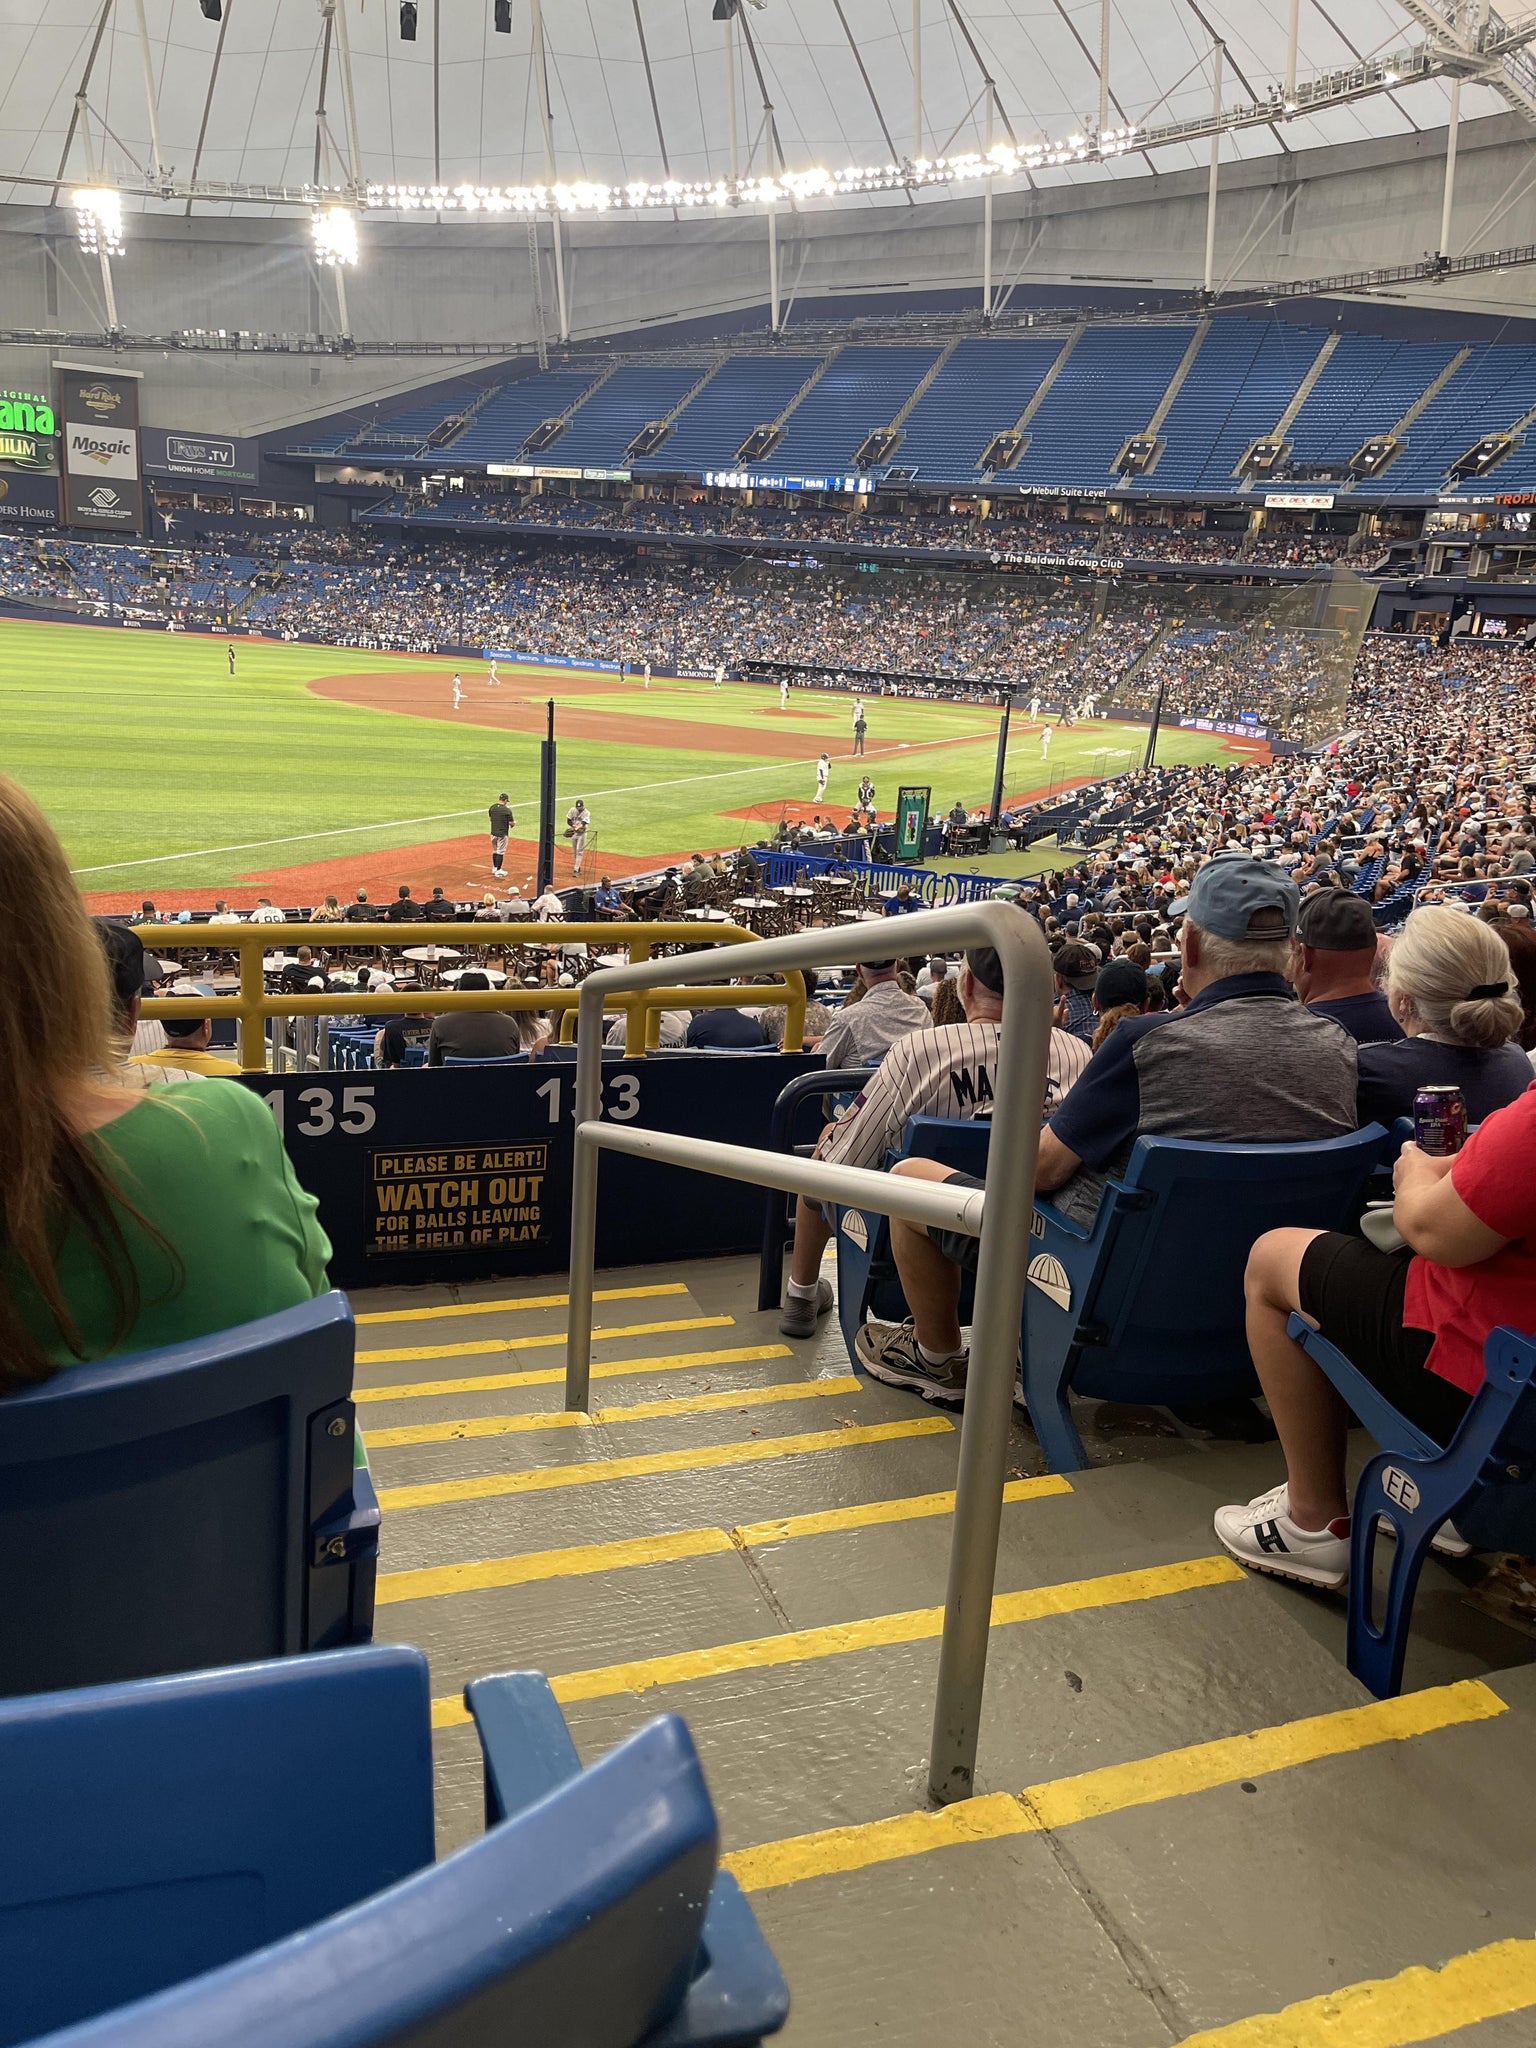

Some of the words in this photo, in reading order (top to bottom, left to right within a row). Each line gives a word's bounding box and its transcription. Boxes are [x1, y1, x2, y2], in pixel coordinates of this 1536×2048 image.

[0, 390, 47, 403] IGINAL
[0, 400, 54, 435] ana
[72, 436, 131, 455] Mosaic
[168, 464, 193, 473] UNION
[193, 468, 216, 476] HOME
[216, 469, 256, 480] MORTGAGE
[1032, 486, 1060, 496] Webull
[1060, 487, 1082, 497] Suite
[1084, 489, 1107, 498] Level
[20, 505, 55, 518] HOMES
[1003, 553, 1022, 563] The
[1024, 555, 1065, 566] Baldwin
[1067, 558, 1099, 569] Group
[1100, 559, 1124, 569] Club
[676, 670, 708, 679] RAYMOND
[535, 1074, 641, 1123] 13
[264, 1086, 376, 1137] 135
[381, 1155, 448, 1175] PLEASE
[454, 1154, 476, 1170] BE
[482, 1150, 542, 1169] ALERT!
[376, 1179, 479, 1212] WATCH
[488, 1175, 544, 1205] OUT
[376, 1215, 409, 1232] FOR
[415, 1211, 467, 1229] BALLS
[472, 1206, 541, 1225] LEAVING
[375, 1235, 409, 1251] THE
[415, 1230, 465, 1249] FIELD
[470, 1228, 493, 1245] OF
[498, 1224, 541, 1243] PLAY
[1386, 1470, 1415, 1510] EE
